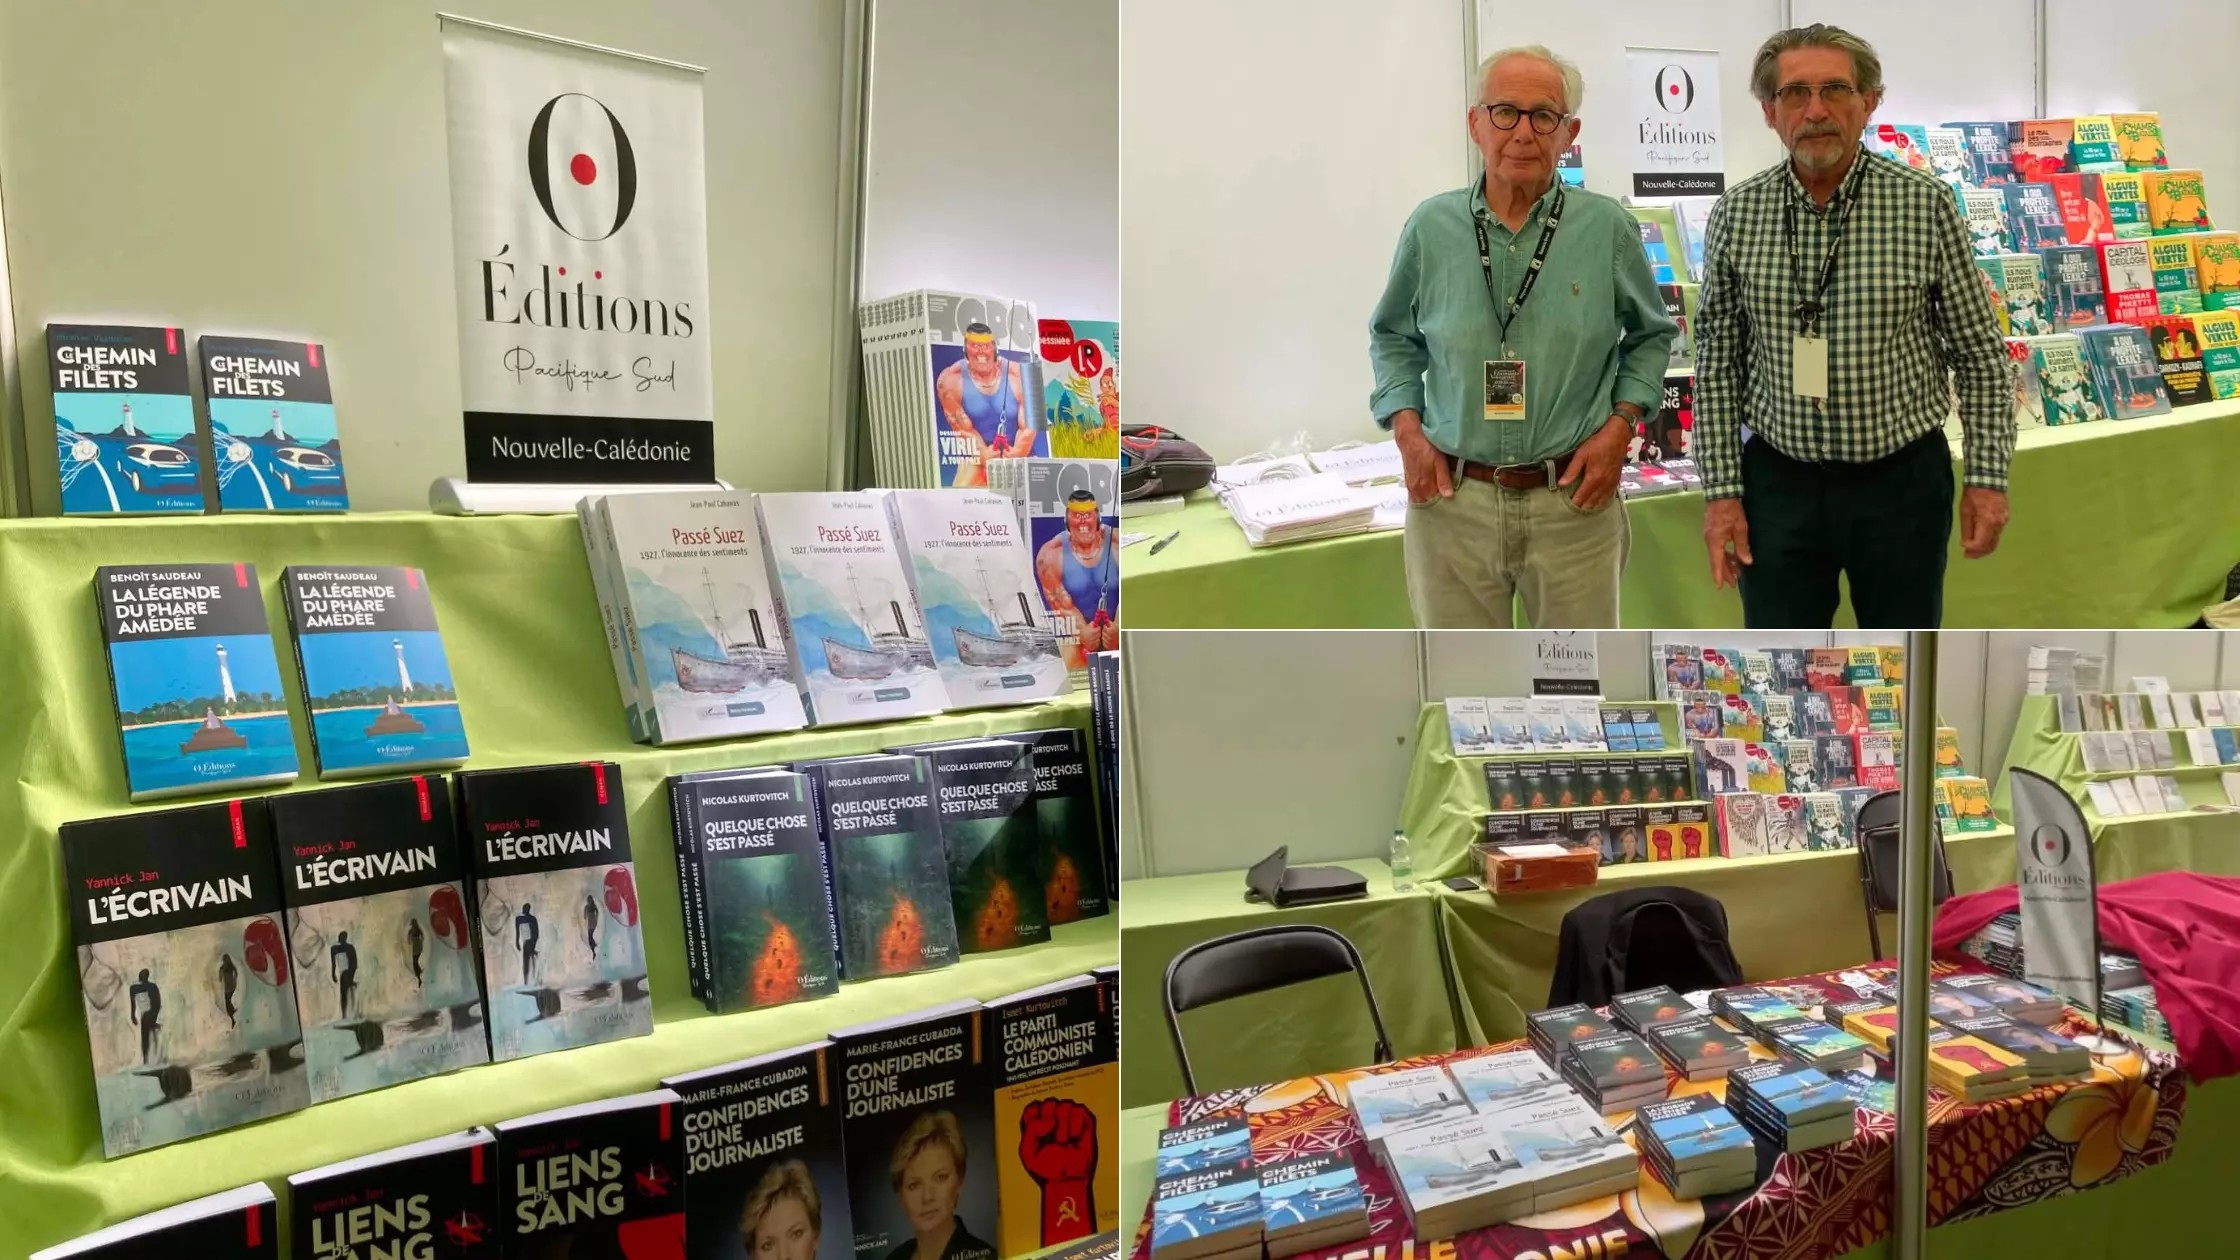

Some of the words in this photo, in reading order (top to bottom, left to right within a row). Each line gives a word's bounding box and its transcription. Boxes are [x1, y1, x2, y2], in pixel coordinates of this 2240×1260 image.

[1639, 117, 1716, 145] Éditions
[2077, 124, 2109, 133] ALGUES
[2080, 132, 2111, 141] VERTES
[528, 93, 637, 242] O
[1642, 180, 1716, 189] Nouvelle-Calédonie
[2030, 188, 2041, 197] QUI
[2106, 180, 2138, 190] ALGUES
[2020, 197, 2049, 206] PROFITE
[2108, 190, 2139, 200] VERTES
[2068, 253, 2081, 262] QUI
[2107, 246, 2146, 258] CAPITAL
[2153, 244, 2187, 256] ALGUES
[2058, 262, 2089, 272] PROFITE
[2155, 255, 2188, 265] VERTES
[479, 244, 693, 338] Éditions
[2120, 292, 2150, 301] THOMAS
[2202, 321, 2235, 333] ALGUES
[2205, 331, 2238, 343] VERTES
[57, 346, 156, 366] CHEMIN
[84, 363, 100, 371] DES
[210, 356, 300, 377] CHEMIN
[504, 346, 622, 392] Pacifique
[632, 356, 676, 392] Sud
[59, 370, 138, 389] FILETS
[213, 378, 285, 397] FILETS
[492, 436, 691, 463] Nouvelle-Calédonie
[939, 437, 980, 456] VIRIL
[672, 528, 710, 546] Passé
[713, 526, 745, 544] Suez
[818, 526, 851, 543] Passé
[854, 526, 881, 542] Suez
[949, 521, 981, 537] Passé
[983, 520, 1009, 536] Suez
[640, 551, 660, 560] 1927,
[700, 549, 711, 558] des
[712, 548, 748, 557] sentiments
[110, 571, 150, 583] BENOÎT
[151, 572, 201, 581] SAUDEAU
[297, 571, 332, 581] BENOÎT
[333, 573, 377, 581] SAUDEAU
[112, 589, 137, 603] LA
[138, 584, 222, 602] LÉGENDE
[300, 586, 322, 599] LA
[322, 583, 396, 599] LÉGENDE
[115, 604, 147, 619] DU
[147, 601, 208, 617] PHARE
[303, 600, 328, 613] DU
[331, 600, 385, 612] PHARE
[118, 615, 196, 635] AMÉDÉE
[306, 611, 375, 628] AMÉDÉE
[1538, 638, 1594, 661] Éditions
[938, 762, 969, 773] NICOLAS
[969, 760, 1013, 771] KURTOVITCH
[1052, 764, 1083, 777] CHOSE
[828, 777, 861, 788] NICOLAS
[862, 773, 910, 785] KURTOVITCH
[1035, 779, 1058, 792] ASSÉ
[702, 795, 738, 806] NICOLAS
[738, 791, 789, 804] KURTOVITCH
[940, 783, 991, 800] QUELQUE
[992, 781, 1028, 794] CHOSE
[831, 798, 890, 817] QUELQUE
[890, 795, 928, 809] CHOSE
[941, 800, 967, 814] S'EST
[968, 795, 998, 812] PASSÉ
[705, 817, 766, 838] QUELQUE
[767, 814, 807, 829] CHOSE
[833, 817, 861, 831] S'EST
[863, 811, 897, 828] PASSÉ
[294, 841, 333, 857] Yannick
[338, 839, 356, 851] Jan
[487, 828, 612, 862] L'ÉCRIVAIN
[706, 836, 737, 852] S'EST
[738, 830, 775, 849] PASSÉ
[296, 845, 436, 890] L'ÉCRIVAIN
[87, 872, 132, 889] Yannick
[139, 870, 159, 882] Jan
[88, 874, 252, 925] L'ÉCRIVAIN
[697, 909, 705, 933] CHOSE
[700, 934, 710, 980] QUELQUE
[1003, 1024, 1018, 1039] LE
[1020, 1014, 1056, 1036] PARTI
[847, 1035, 917, 1058] MARIE-FRANCE
[919, 1025, 963, 1043] CUBADDA
[1004, 1021, 1096, 1055] COMMUNISTE
[846, 1043, 963, 1082] CONFIDENCES
[682, 1078, 761, 1105] MARIE-FRANCE
[762, 1065, 808, 1086] CUBADDA
[847, 1075, 898, 1101] D'UNE
[683, 1085, 809, 1133] CONFIDENCES
[846, 1080, 955, 1119] JOURNALISTE
[686, 1123, 742, 1154] D'UNE
[1162, 1121, 1229, 1142] CHEMIN
[1162, 1130, 1214, 1148] FILETS
[687, 1125, 804, 1175] JOURNALISTE
[516, 1146, 621, 1197] LIENS
[1262, 1158, 1330, 1179] CHEMIN
[1262, 1168, 1318, 1187] FILETS
[1159, 1169, 1233, 1190] CHEMIN
[534, 1189, 550, 1203] DE
[1160, 1181, 1218, 1200] FILETS
[516, 1182, 625, 1234] SANG
[312, 1194, 431, 1254] LIENS
[332, 1245, 350, 1259] DE
